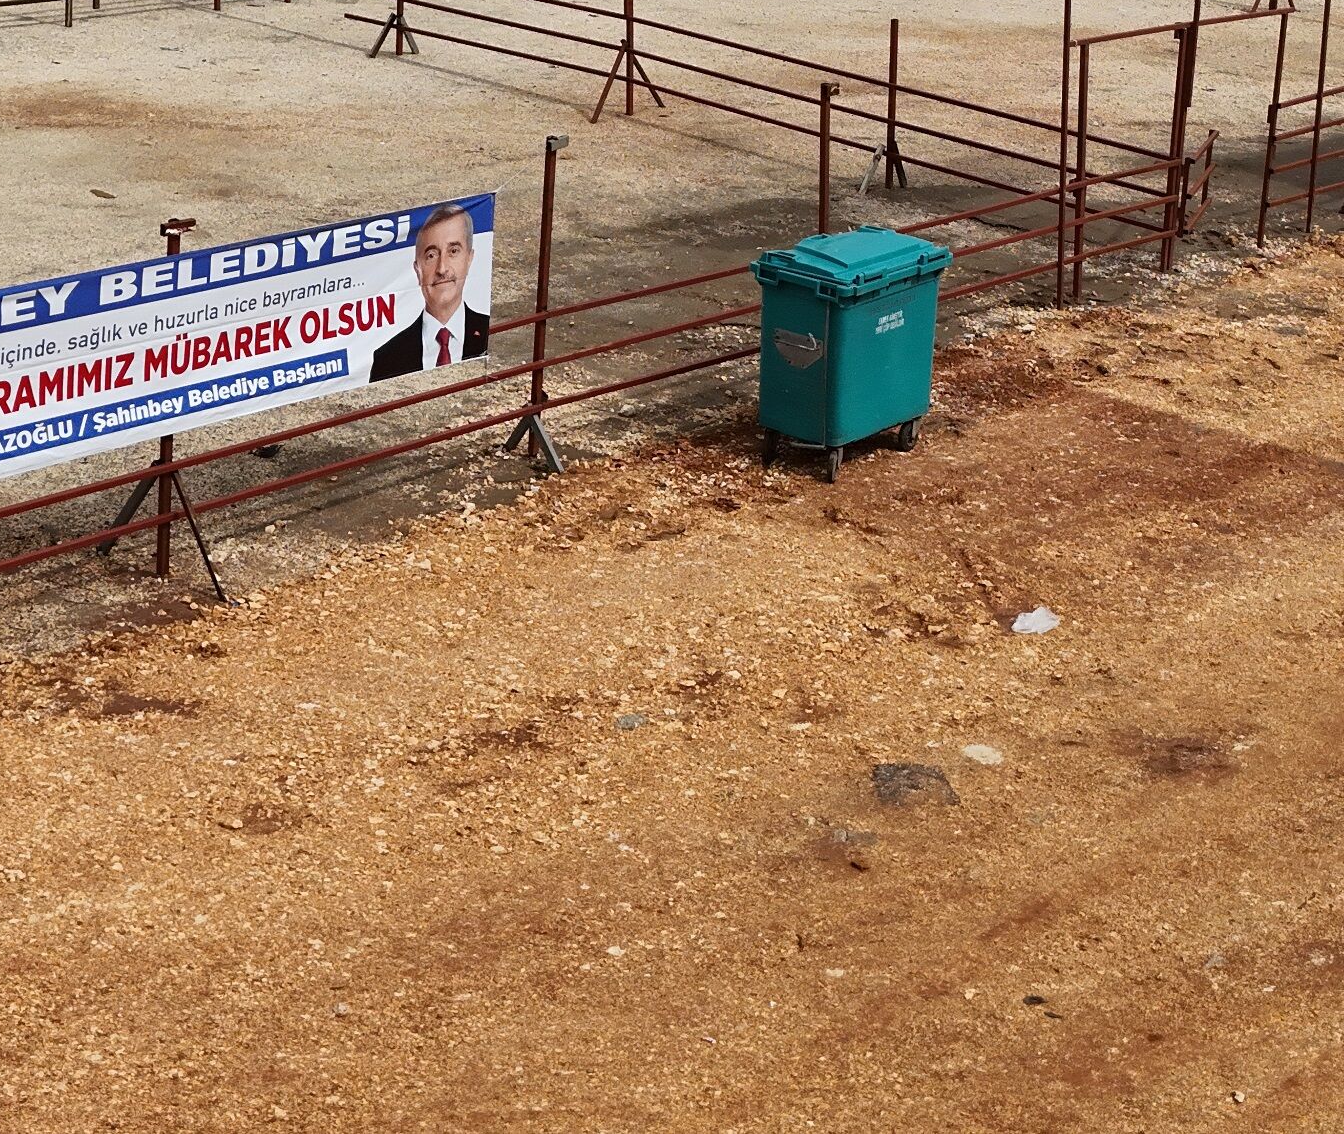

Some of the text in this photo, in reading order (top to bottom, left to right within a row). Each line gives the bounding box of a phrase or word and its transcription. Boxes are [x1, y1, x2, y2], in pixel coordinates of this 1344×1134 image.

[98, 215, 412, 306] BELEDİYESİ
[67, 323, 122, 352] sağlık
[128, 321, 148, 338] ve
[154, 303, 218, 332] huzurla
[224, 295, 258, 317] nice
[262, 276, 366, 310] bayramlara...
[143, 315, 292, 382] MÜBAREK
[299, 293, 396, 344] OLSUN
[78, 414, 90, 437] /
[93, 396, 184, 434] Şahinbey
[188, 376, 270, 408] Belediye
[272, 357, 342, 391] Başkanı
